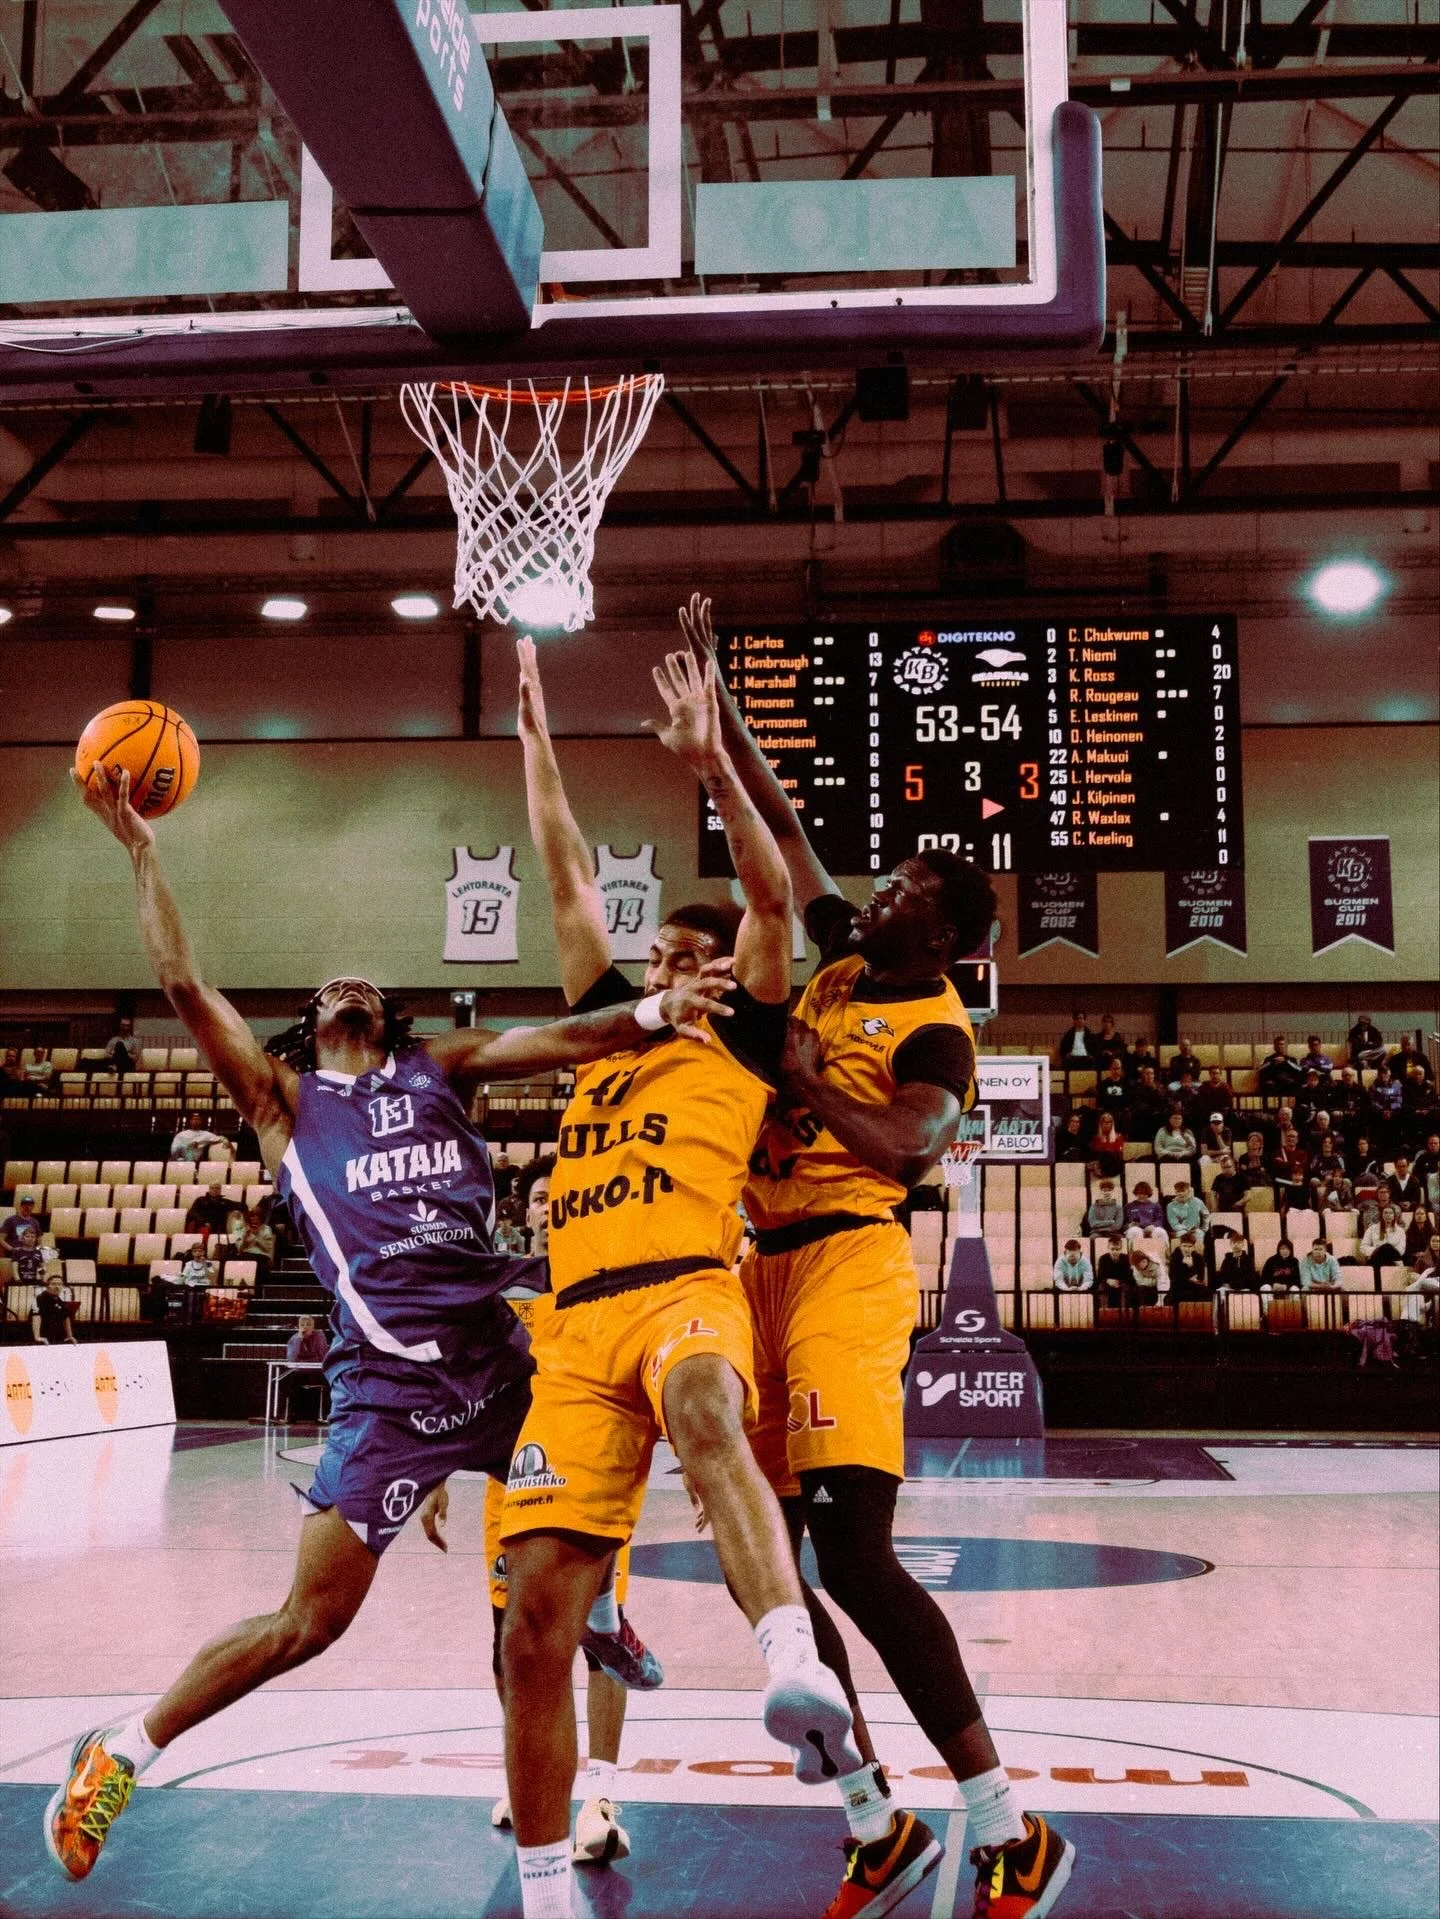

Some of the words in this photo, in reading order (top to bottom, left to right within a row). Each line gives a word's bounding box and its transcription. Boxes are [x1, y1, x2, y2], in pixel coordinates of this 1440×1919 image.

[730, 637, 740, 649] J.
[745, 636, 784, 649] Carlos
[869, 632, 878, 647] 0
[937, 631, 1016, 643] DIGITEKNO
[1047, 628, 1056, 643] 0
[1069, 629, 1080, 642] C.
[1085, 628, 1149, 642] Chukwuma
[1212, 625, 1220, 638] 4
[729, 656, 740, 669] J.
[745, 655, 808, 670] Kimbrough
[869, 652, 882, 666] 13
[1048, 648, 1056, 663] 2
[1069, 648, 1078, 662] T.
[1082, 648, 1116, 662] Niemi
[1213, 644, 1221, 659] 0
[729, 677, 741, 689] J.
[745, 675, 796, 688] Marshall
[869, 672, 877, 686] 7
[1048, 668, 1056, 683] 3
[1070, 669, 1080, 682] K.
[1084, 668, 1115, 682] Ross
[1214, 664, 1231, 679] 20
[745, 696, 794, 708] Timonen
[870, 693, 878, 706] 11
[1048, 689, 1056, 703] 4
[1070, 689, 1081, 702] R.
[1086, 688, 1139, 704] Rougeau
[1213, 685, 1221, 699] 7
[870, 713, 879, 727] 0
[1049, 709, 1057, 723] 5
[1071, 709, 1080, 722] E.
[1085, 709, 1138, 722] Leskinen
[1215, 706, 1223, 720] 0
[915, 704, 1023, 742] 53-54
[870, 733, 879, 747] 0
[1049, 729, 1062, 744] 10
[1087, 729, 1143, 743] Heinonen
[1215, 726, 1224, 740] 2
[870, 753, 879, 767] 6
[1049, 749, 1067, 764] 22
[1072, 750, 1083, 763] A.
[870, 773, 879, 787] 6
[904, 765, 925, 802] 5
[963, 760, 983, 793] 3
[1018, 763, 1041, 800] 3
[1050, 770, 1067, 784] 25
[1072, 771, 1081, 784] L.
[1086, 770, 1132, 783] Hervola
[1216, 767, 1225, 781] 0
[870, 793, 879, 807] 0
[1050, 790, 1066, 805] 40
[1072, 791, 1083, 804] J.
[1088, 790, 1135, 806] Kilpinen
[1217, 787, 1226, 802] 0
[871, 813, 883, 828] 10
[1050, 810, 1065, 825] 47
[1073, 811, 1084, 824] R.
[1088, 811, 1130, 824] Waxlax
[1217, 808, 1225, 822] 4
[871, 834, 879, 848] 0
[1051, 831, 1068, 846] 55
[1073, 831, 1084, 845] C.
[1089, 832, 1133, 847] Keeling
[1218, 829, 1226, 843] 11
[871, 854, 880, 869] 0
[1219, 849, 1228, 864] 0
[452, 879, 512, 898] LEHTORANTA
[601, 879, 649, 892] VIRTANEN
[1324, 898, 1379, 906] SUOMEN
[461, 900, 502, 934] 15
[605, 898, 645, 933] 14
[1040, 916, 1077, 928] 2002
[1189, 915, 1224, 927] 2010
[1335, 913, 1367, 926] 2011
[1012, 1078, 1031, 1087] OY
[997, 1137, 1037, 1148] ABLOY
[345, 1140, 462, 1193] KATAJA
[371, 1180, 452, 1202] BASKET
[410, 1221, 448, 1235] SUOMEN
[974, 1336, 1001, 1344] Sports
[959, 1389, 1024, 1407] SPORT
